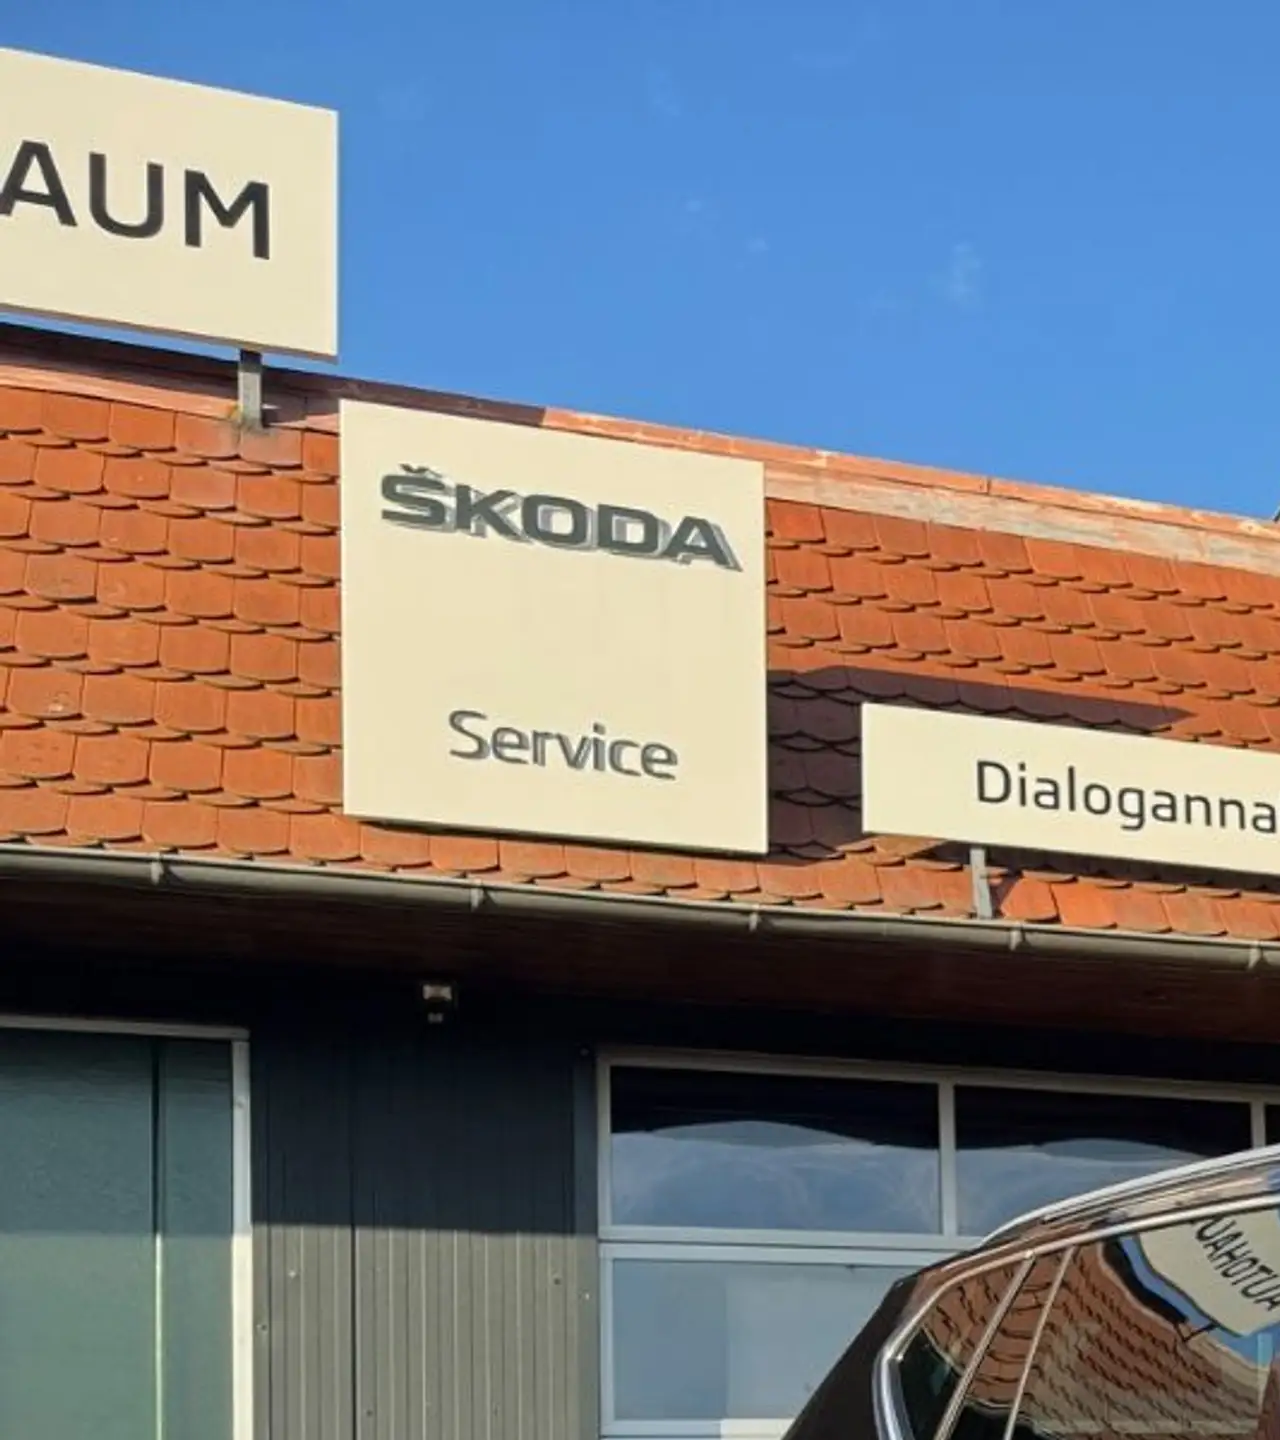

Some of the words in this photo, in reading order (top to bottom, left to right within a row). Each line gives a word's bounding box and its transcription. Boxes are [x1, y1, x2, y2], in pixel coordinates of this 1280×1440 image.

[0, 141, 270, 260] AUM
[379, 463, 742, 573] ŠKODA
[448, 709, 679, 781] Service
